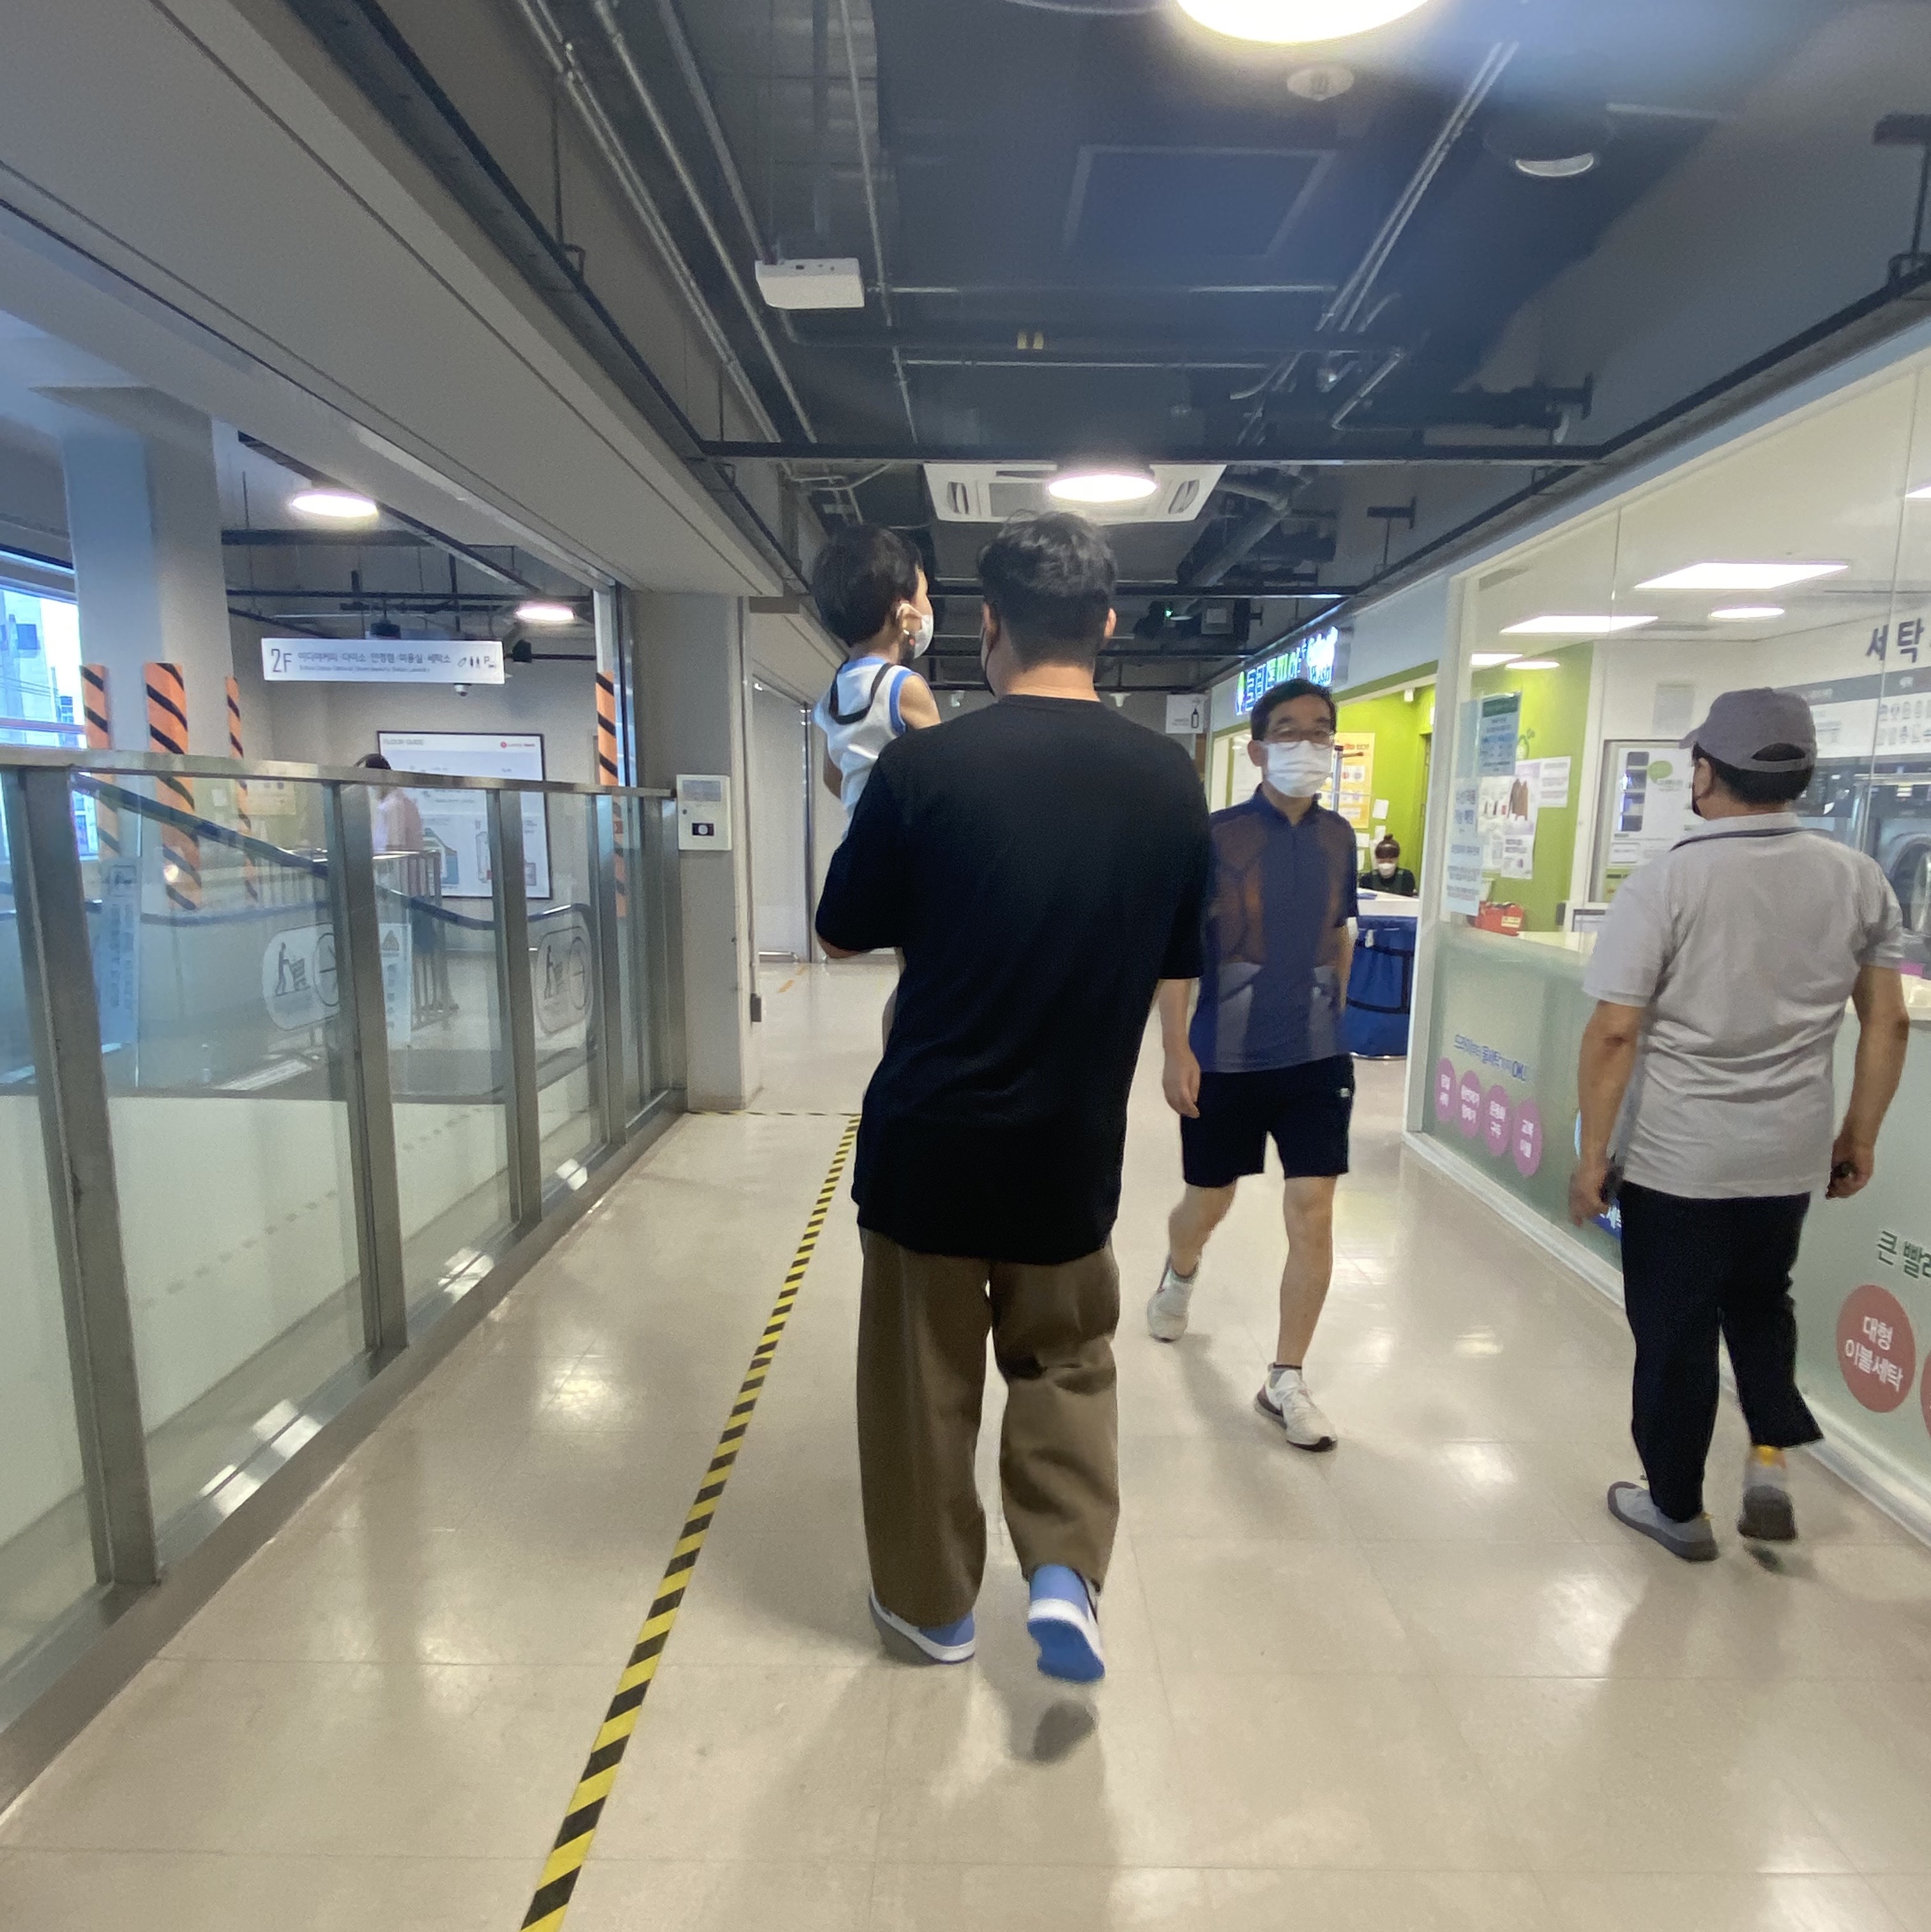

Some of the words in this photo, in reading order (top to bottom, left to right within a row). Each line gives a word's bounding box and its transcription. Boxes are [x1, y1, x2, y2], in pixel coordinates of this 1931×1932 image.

[271, 649, 292, 673] 2F
[1877, 1230, 1897, 1266] 큰
[1863, 1316, 1894, 1351] 대형
[1845, 1339, 1904, 1392] 이불세탁
